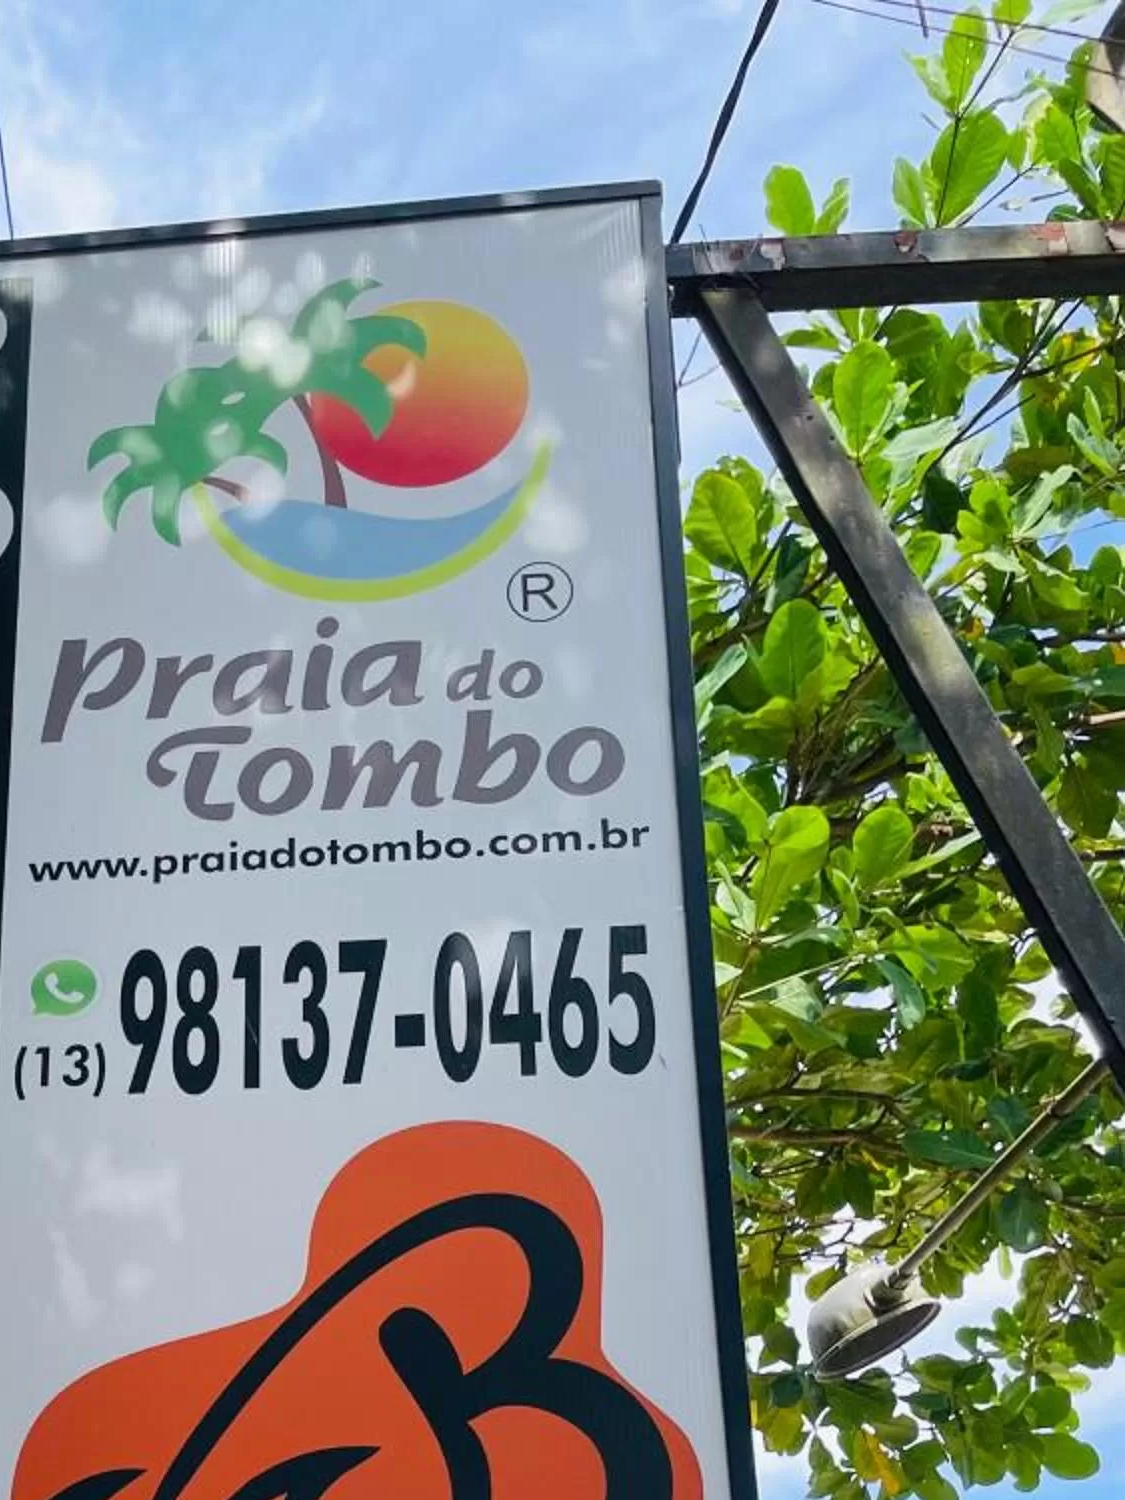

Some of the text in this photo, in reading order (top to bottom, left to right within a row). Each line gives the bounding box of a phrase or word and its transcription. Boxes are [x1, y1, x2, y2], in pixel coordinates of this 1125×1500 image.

[446, 650, 543, 699] do
[146, 710, 625, 821] Tombo
[28, 820, 650, 883] www.praiadotombo.com.br
[14, 924, 656, 1099] (13) 98137-0465
